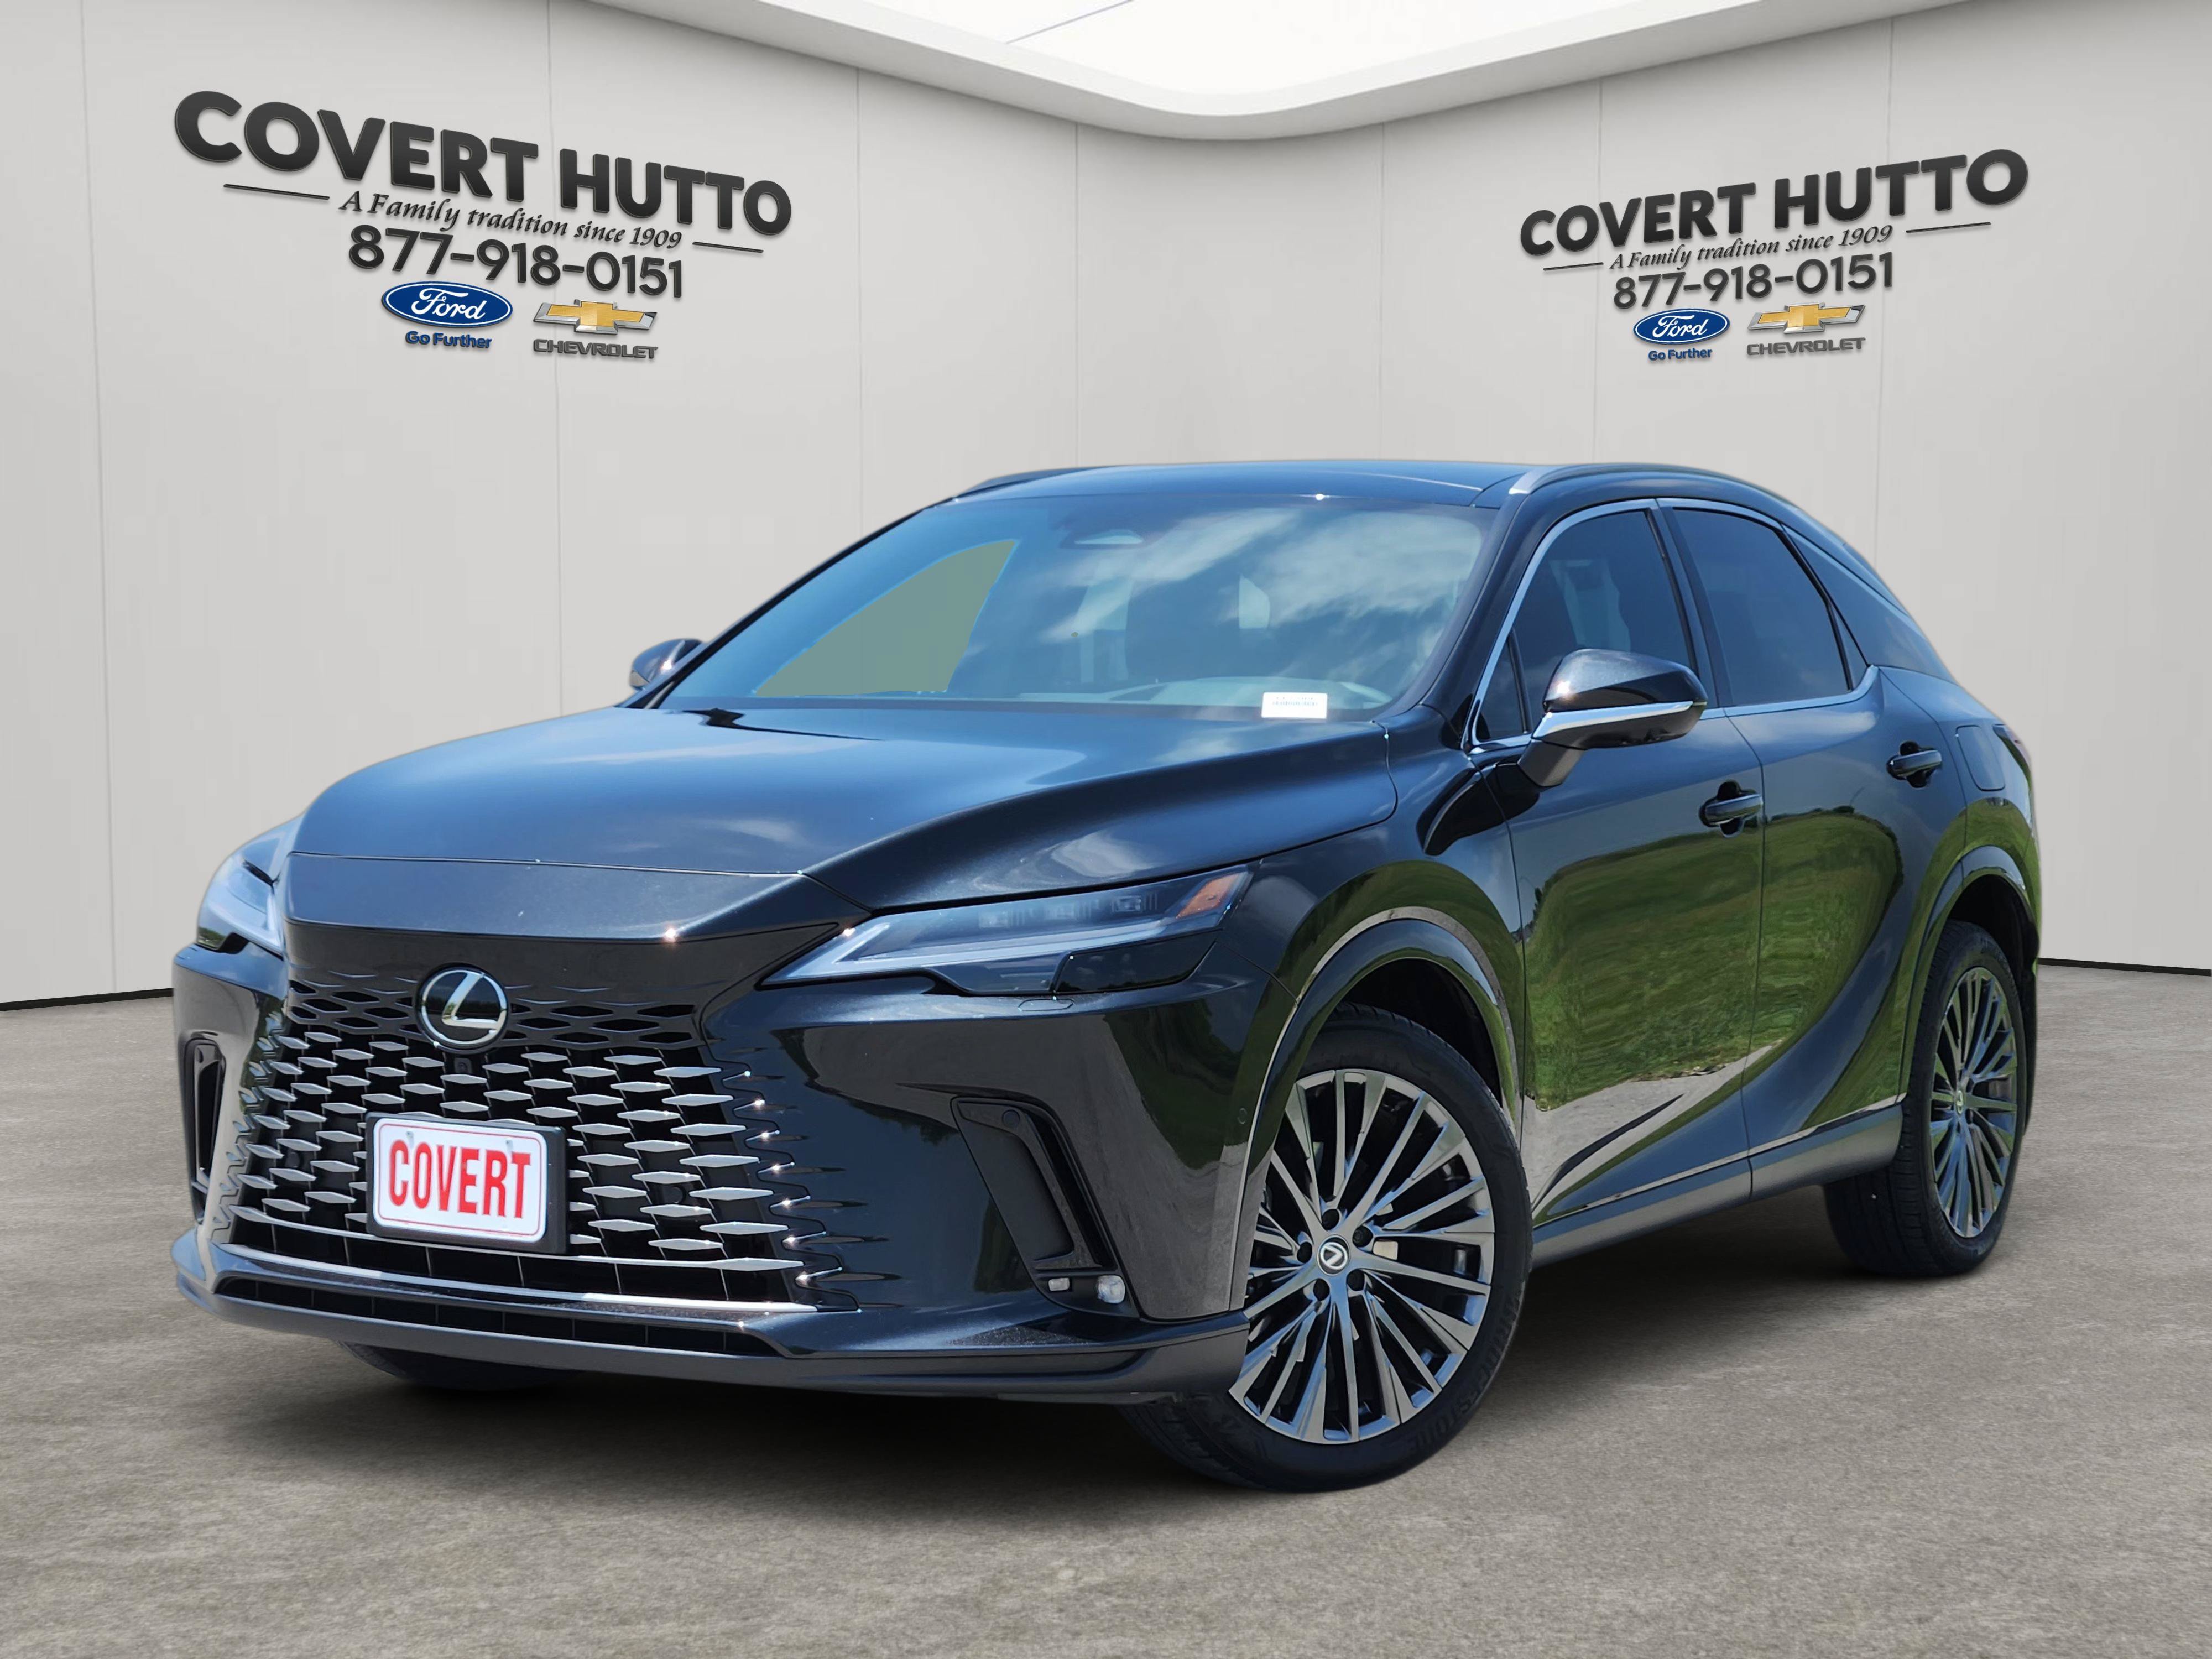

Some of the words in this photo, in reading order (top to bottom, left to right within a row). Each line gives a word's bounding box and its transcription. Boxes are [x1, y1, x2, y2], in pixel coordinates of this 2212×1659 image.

[175, 90, 539, 202] COVERT
[560, 148, 792, 236] HUTTO
[338, 190, 363, 211] A
[367, 193, 460, 231] Family
[467, 208, 568, 238] tradition
[574, 220, 625, 242] since
[629, 227, 682, 250] 1909
[1520, 182, 1756, 256] COVERT
[1775, 148, 2028, 228] HUTTO
[348, 225, 683, 298] 877-918-0151
[1608, 253, 1625, 270] A
[1626, 244, 1691, 270] Family
[1697, 238, 1780, 261] tradition
[1786, 233, 1834, 252] since
[1837, 225, 1893, 247] 1909
[1614, 251, 1893, 309] 877-918-0151
[411, 288, 488, 322] Ford
[1651, 314, 1709, 338] Ford
[405, 331, 430, 346] Go
[434, 332, 492, 349] Further
[533, 338, 658, 358] CHEVROLET
[1648, 350, 1666, 361] Go
[1668, 348, 1713, 359] Further
[1746, 338, 1866, 356] CHEVROLET
[389, 1139, 531, 1219] COVERT
